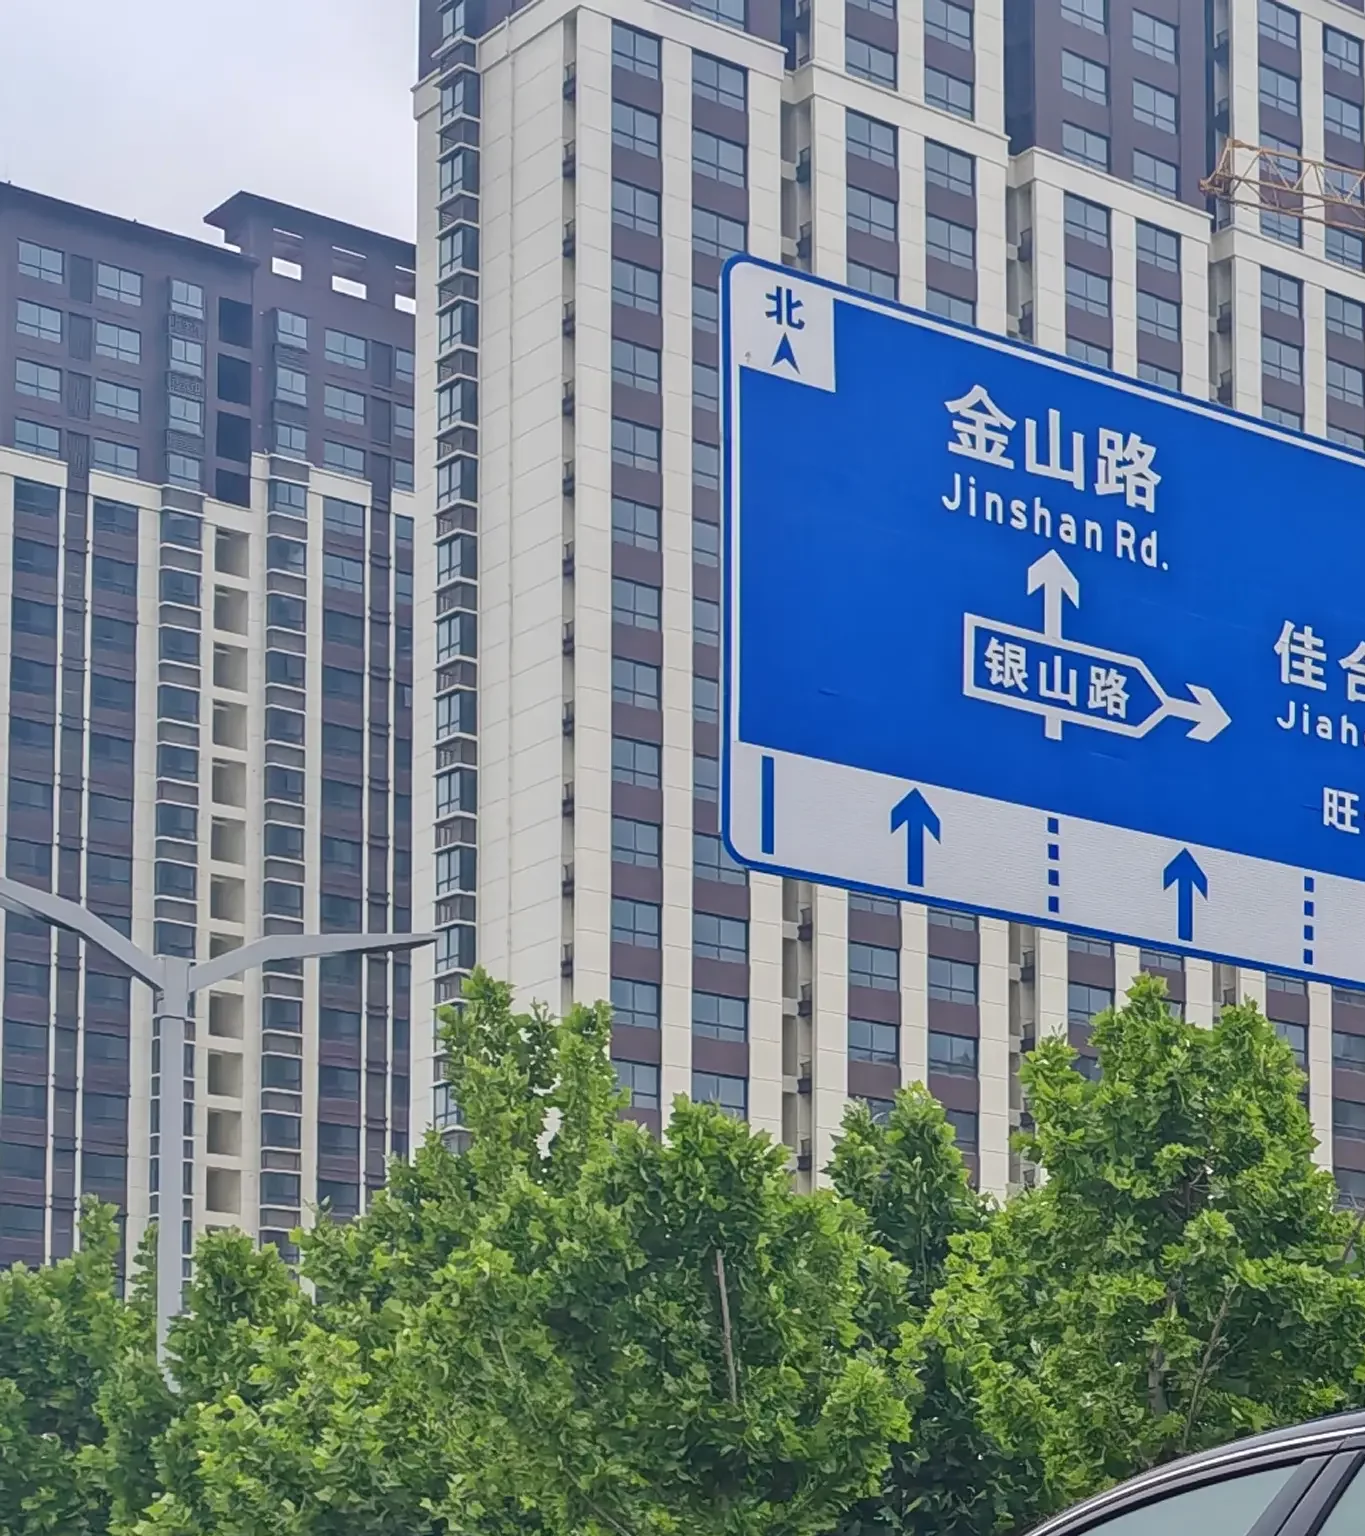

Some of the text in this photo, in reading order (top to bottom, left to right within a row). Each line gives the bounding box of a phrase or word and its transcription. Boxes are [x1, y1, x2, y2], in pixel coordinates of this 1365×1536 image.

[765, 286, 806, 330] 北
[944, 384, 1162, 513] 金山路
[941, 473, 1170, 572] Jinshan Rd.
[983, 636, 1130, 719] 银山路
